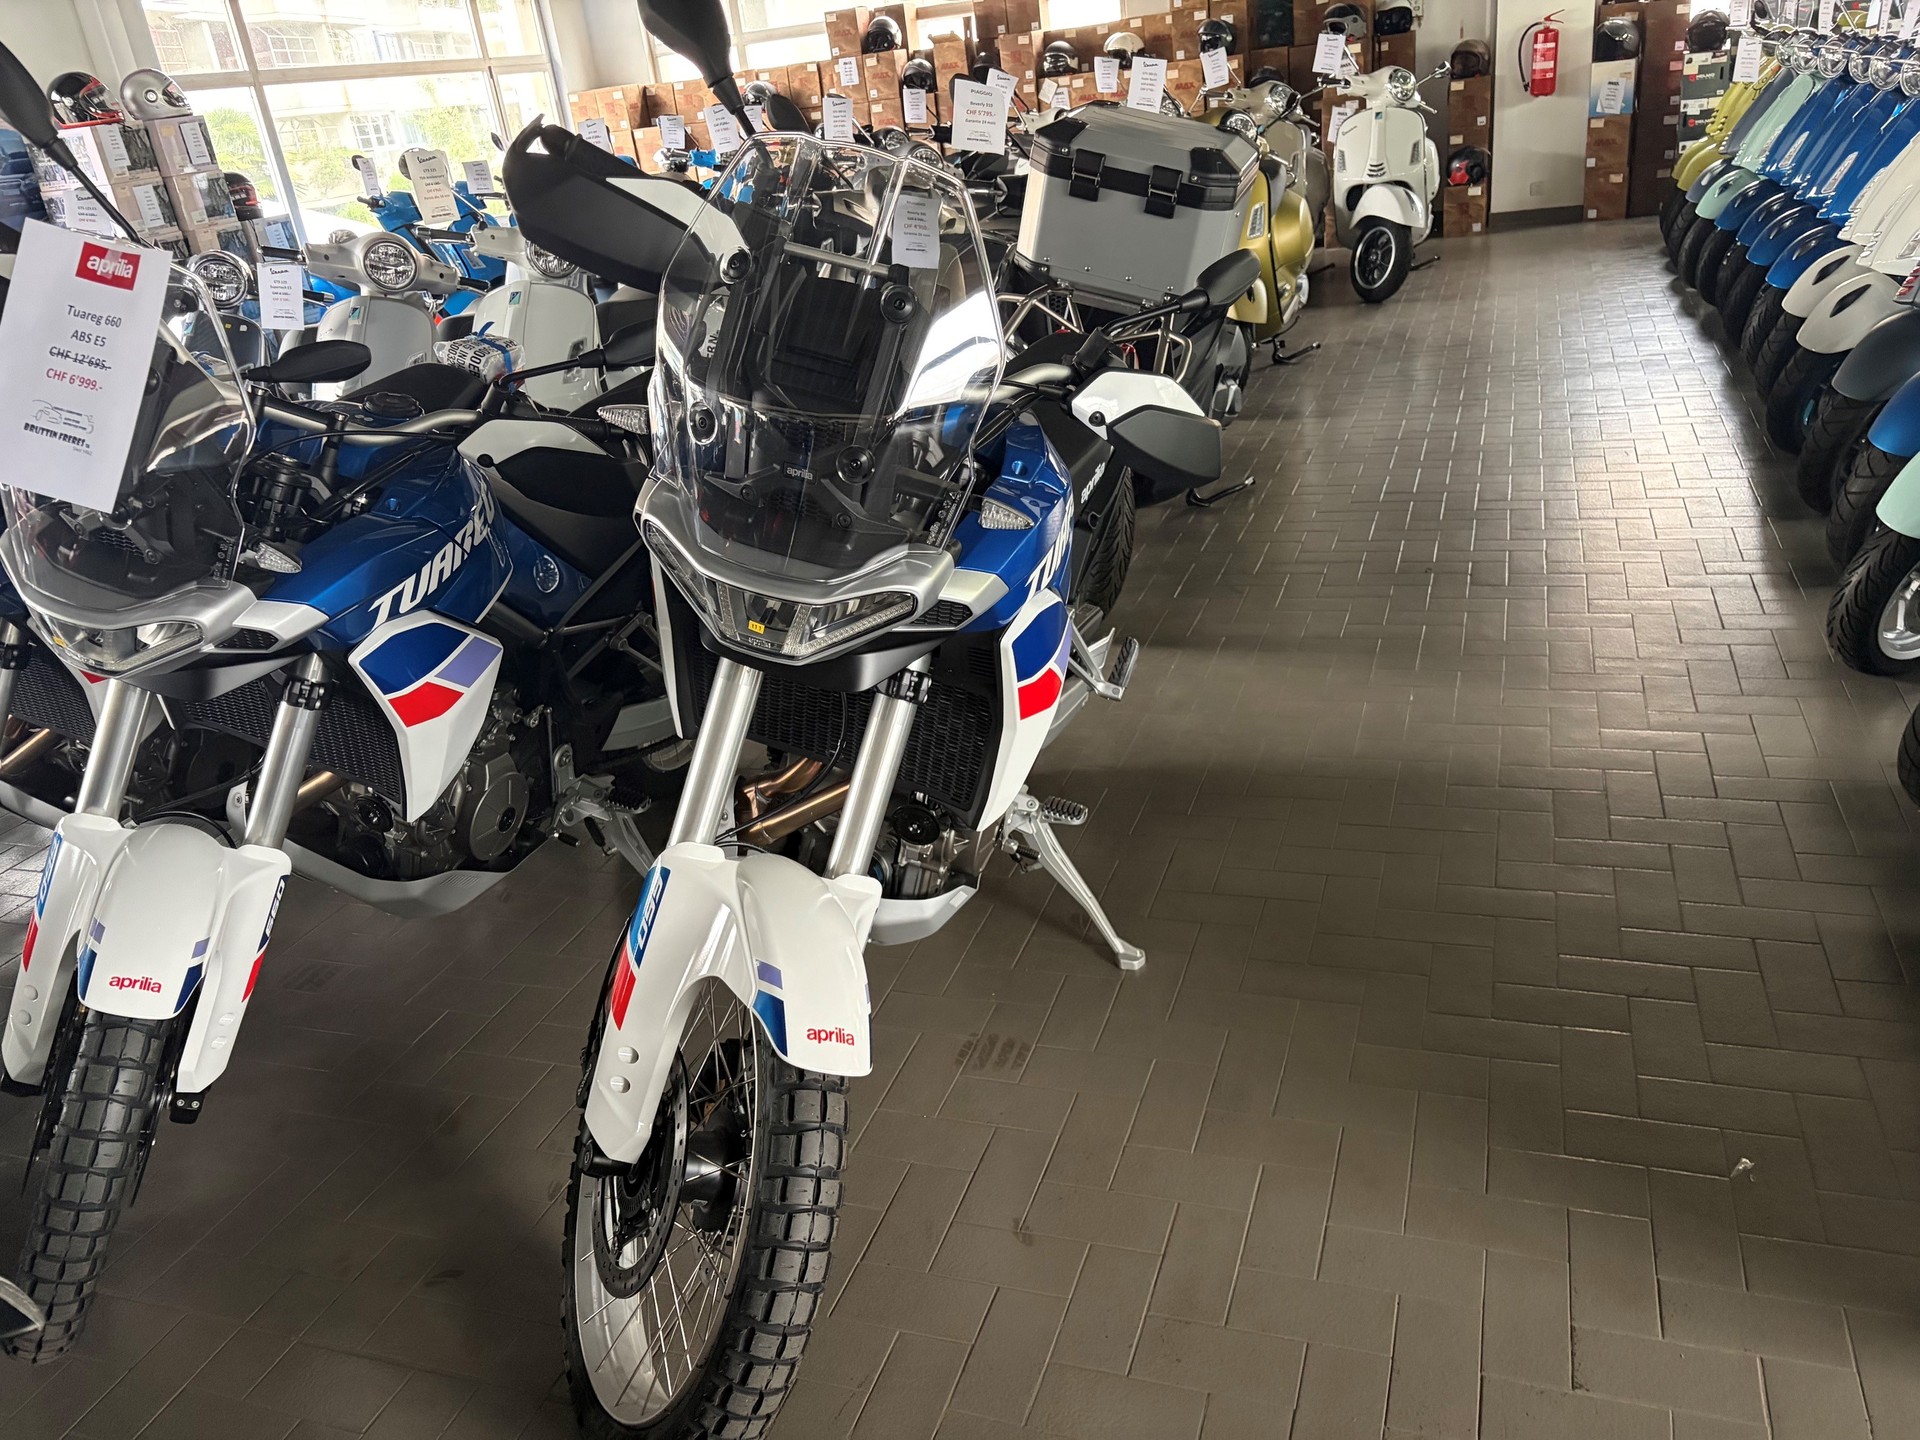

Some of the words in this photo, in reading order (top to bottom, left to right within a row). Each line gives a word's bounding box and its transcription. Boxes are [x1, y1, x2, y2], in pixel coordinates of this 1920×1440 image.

[970, 89, 993, 97] PIAGGIO
[87, 254, 133, 280] aprilia
[67, 304, 103, 327] Tuareg
[104, 314, 122, 328] 660
[70, 330, 93, 346] ABS
[94, 335, 107, 347] E5
[48, 346, 71, 362] CHF
[46, 367, 67, 383] CHF
[68, 374, 103, 392] 6'999.-
[23, 422, 59, 439] BRUTTIN
[786, 467, 813, 480] aprilia
[109, 975, 162, 994] aprilia
[807, 1027, 855, 1047] aprilia
